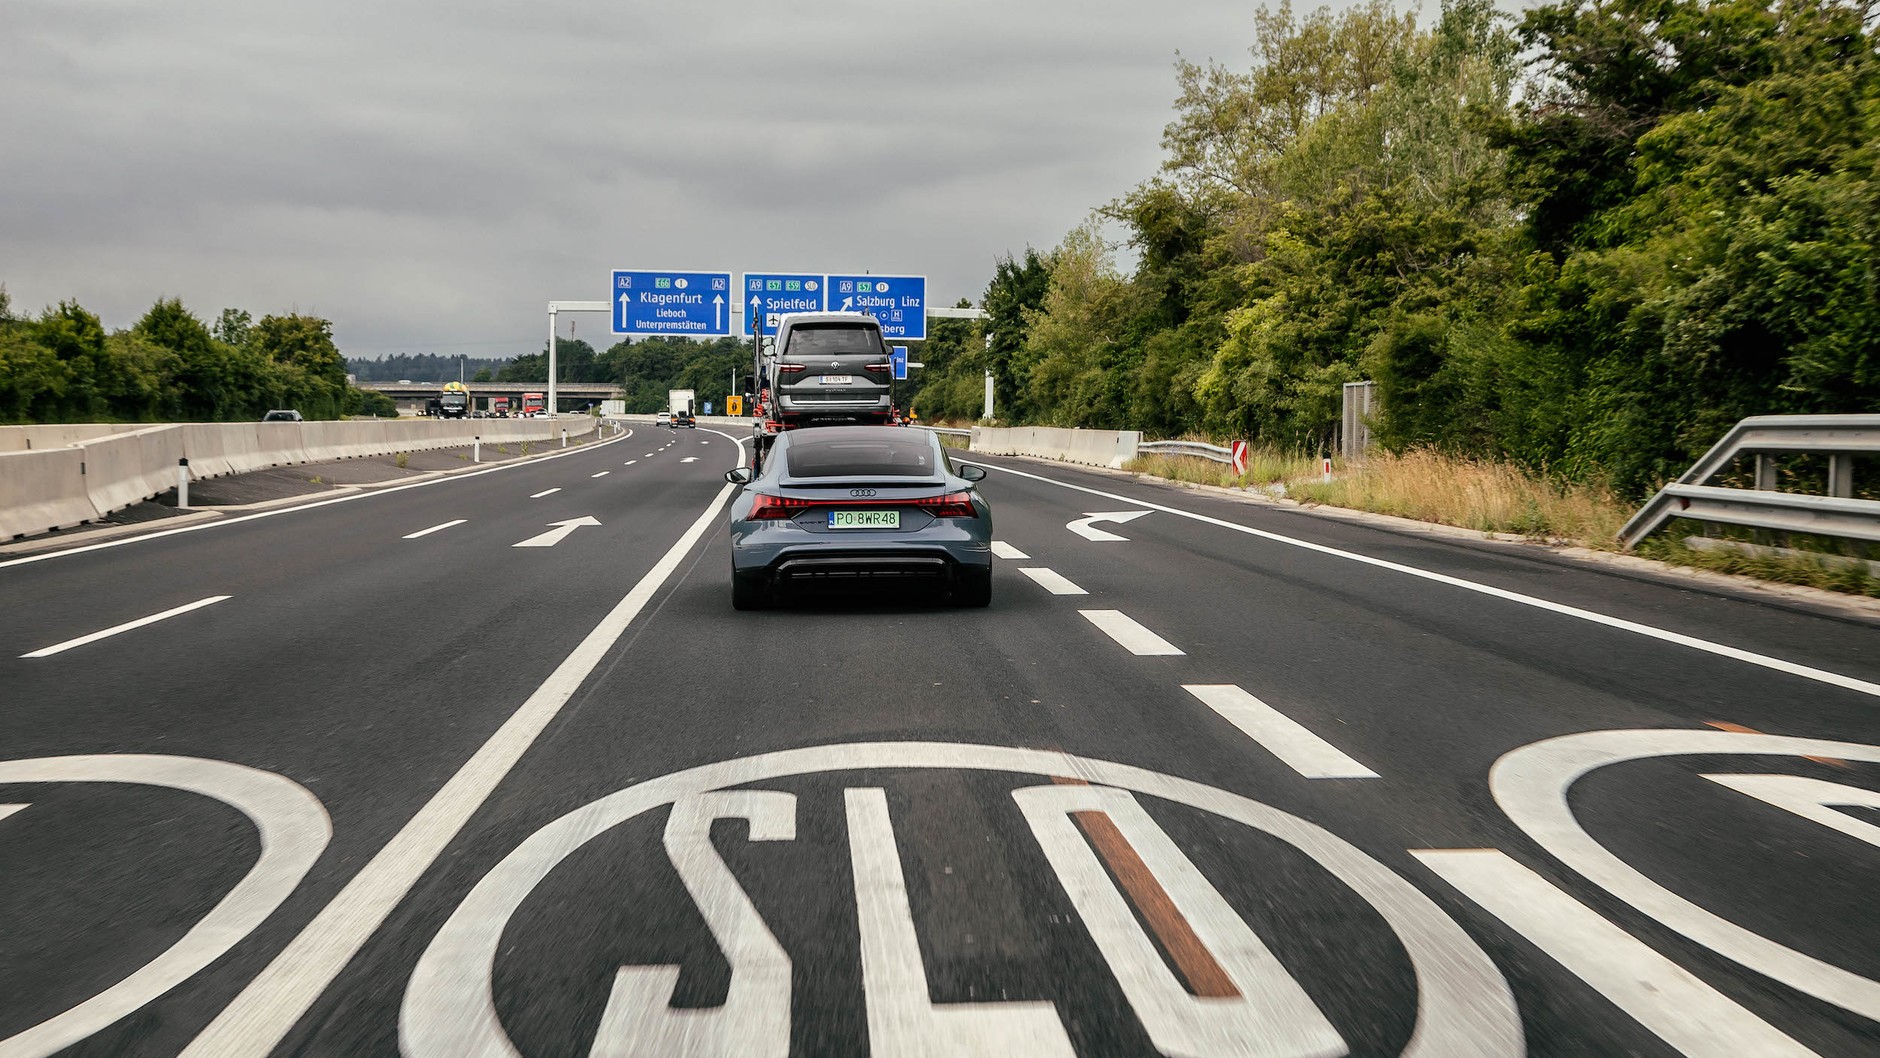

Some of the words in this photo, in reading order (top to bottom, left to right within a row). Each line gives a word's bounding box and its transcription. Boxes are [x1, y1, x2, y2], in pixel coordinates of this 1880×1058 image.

[619, 278, 629, 287] A2
[656, 278, 669, 288] E66
[714, 280, 724, 289] A2
[751, 280, 761, 289] A9
[767, 281, 779, 290] E57
[786, 281, 799, 290] E59
[806, 282, 816, 290] SLO
[841, 282, 851, 291] A9
[858, 283, 870, 291] E57
[640, 291, 702, 306] Klagenfurt
[856, 295, 895, 309] Salzburg
[902, 295, 920, 307] Linz
[766, 298, 817, 311] Spielfeld
[656, 308, 687, 318] Lieboch
[635, 319, 707, 331] Unterpremstätten
[881, 324, 905, 335] sberg
[836, 512, 853, 525] PO
[857, 512, 896, 525] 8WR48
[588, 786, 1350, 1058] SLO
